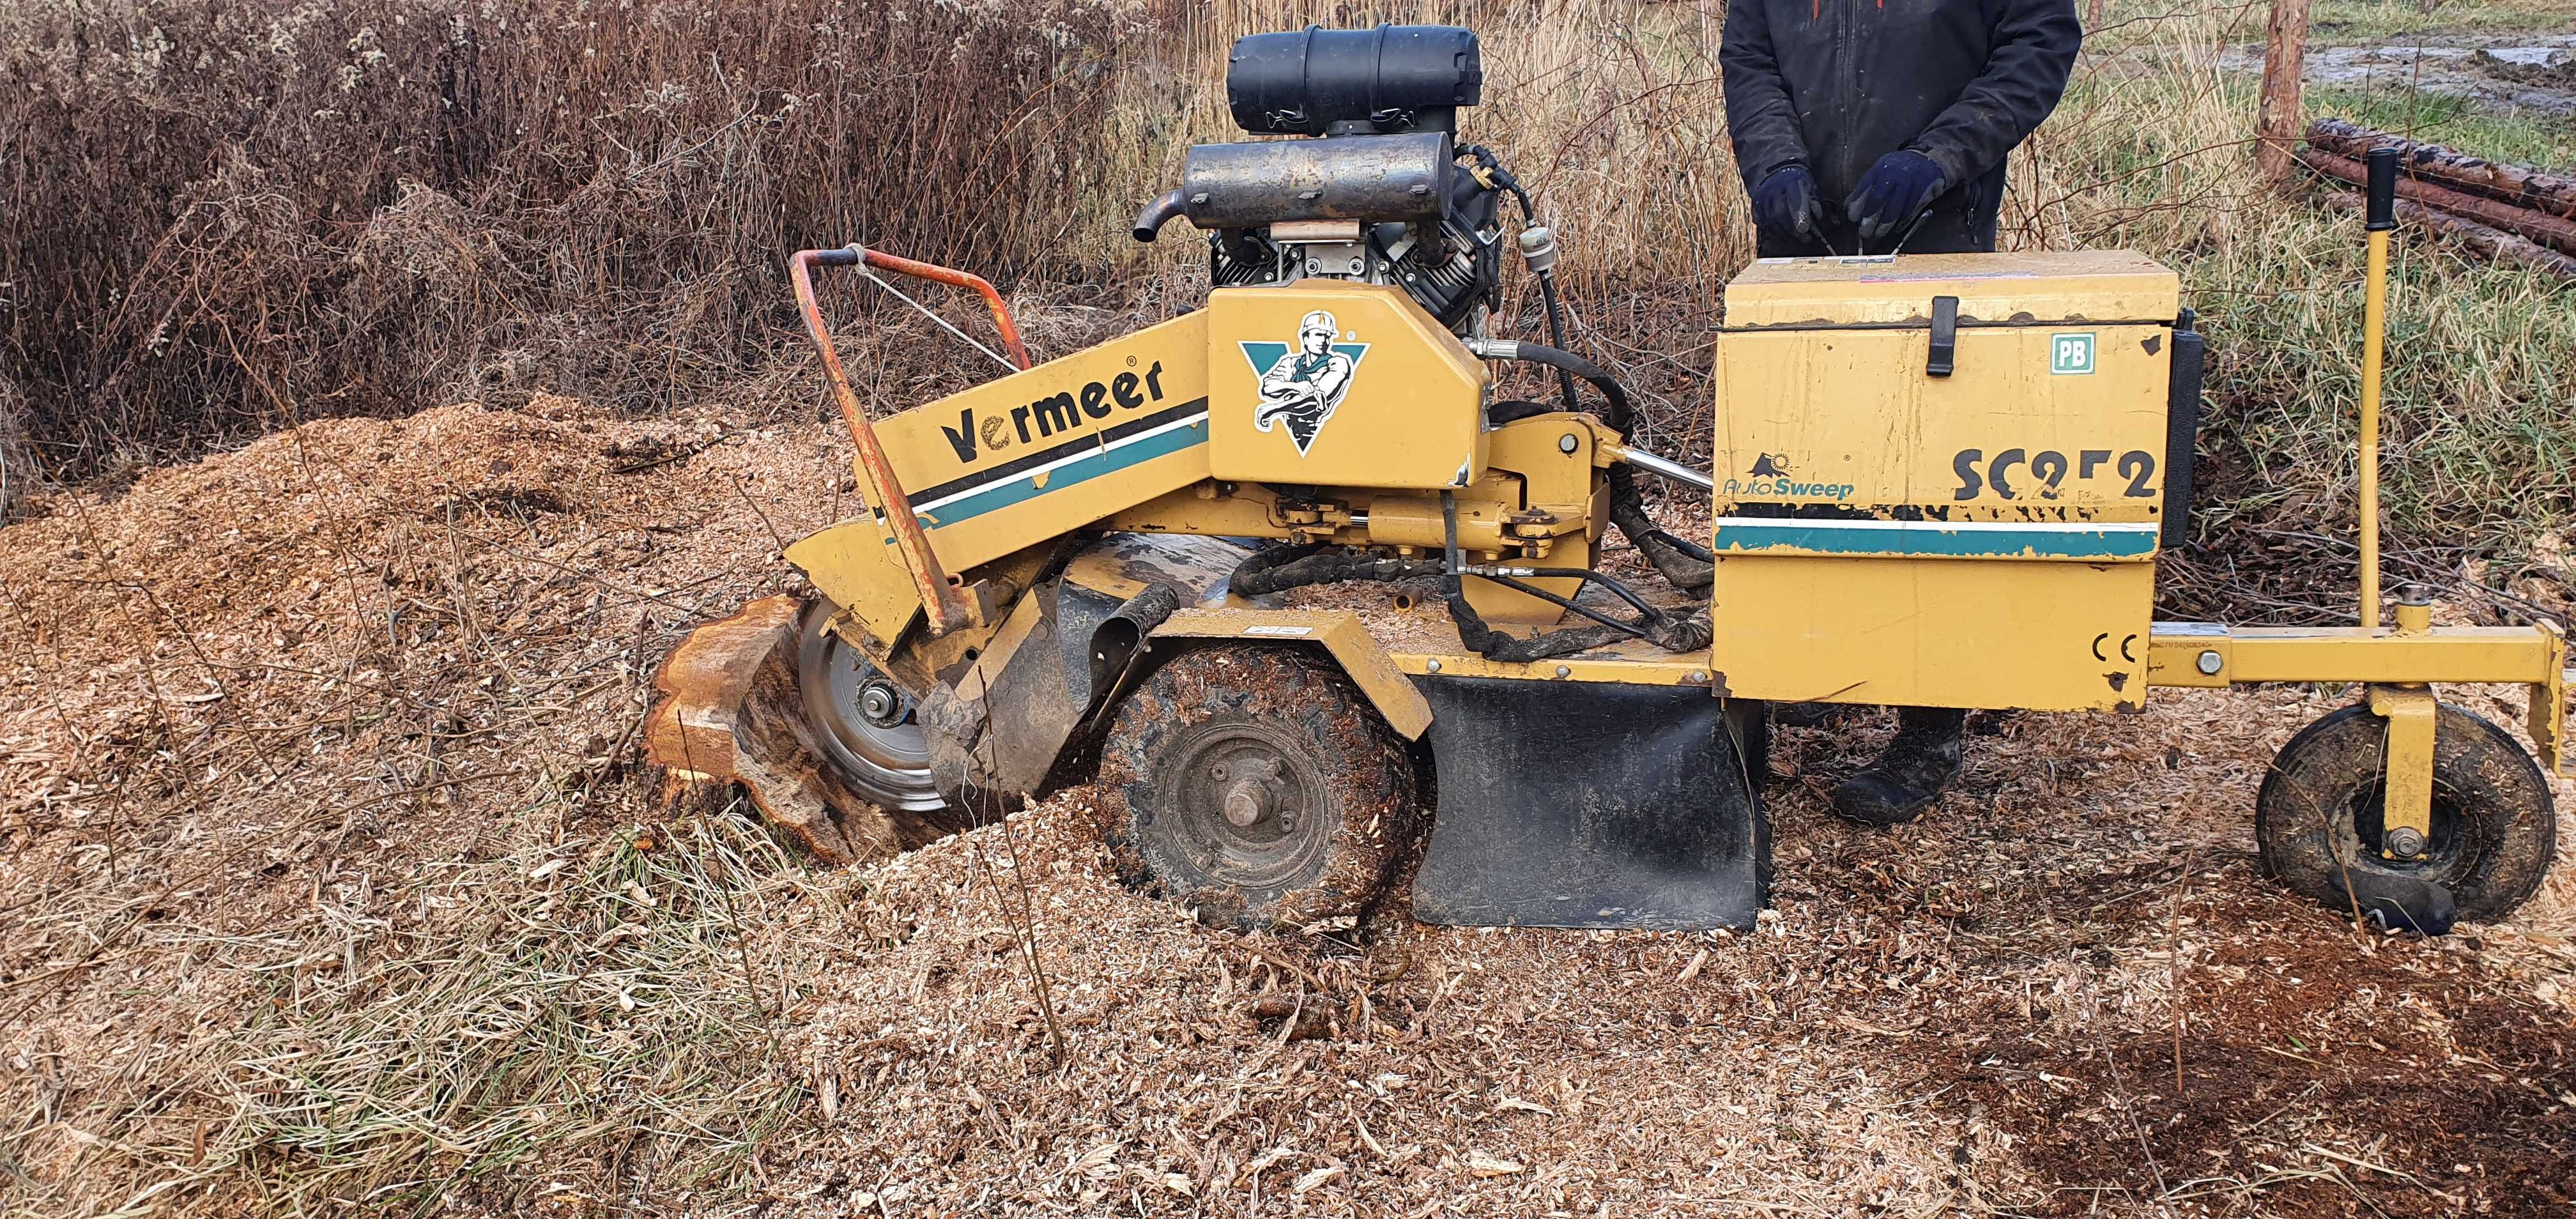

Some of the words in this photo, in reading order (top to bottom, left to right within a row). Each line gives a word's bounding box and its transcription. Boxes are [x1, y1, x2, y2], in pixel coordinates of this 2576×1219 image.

[2059, 340, 2086, 367] PB
[941, 360, 1162, 463] Vermeer
[2092, 632, 2136, 663] CE
